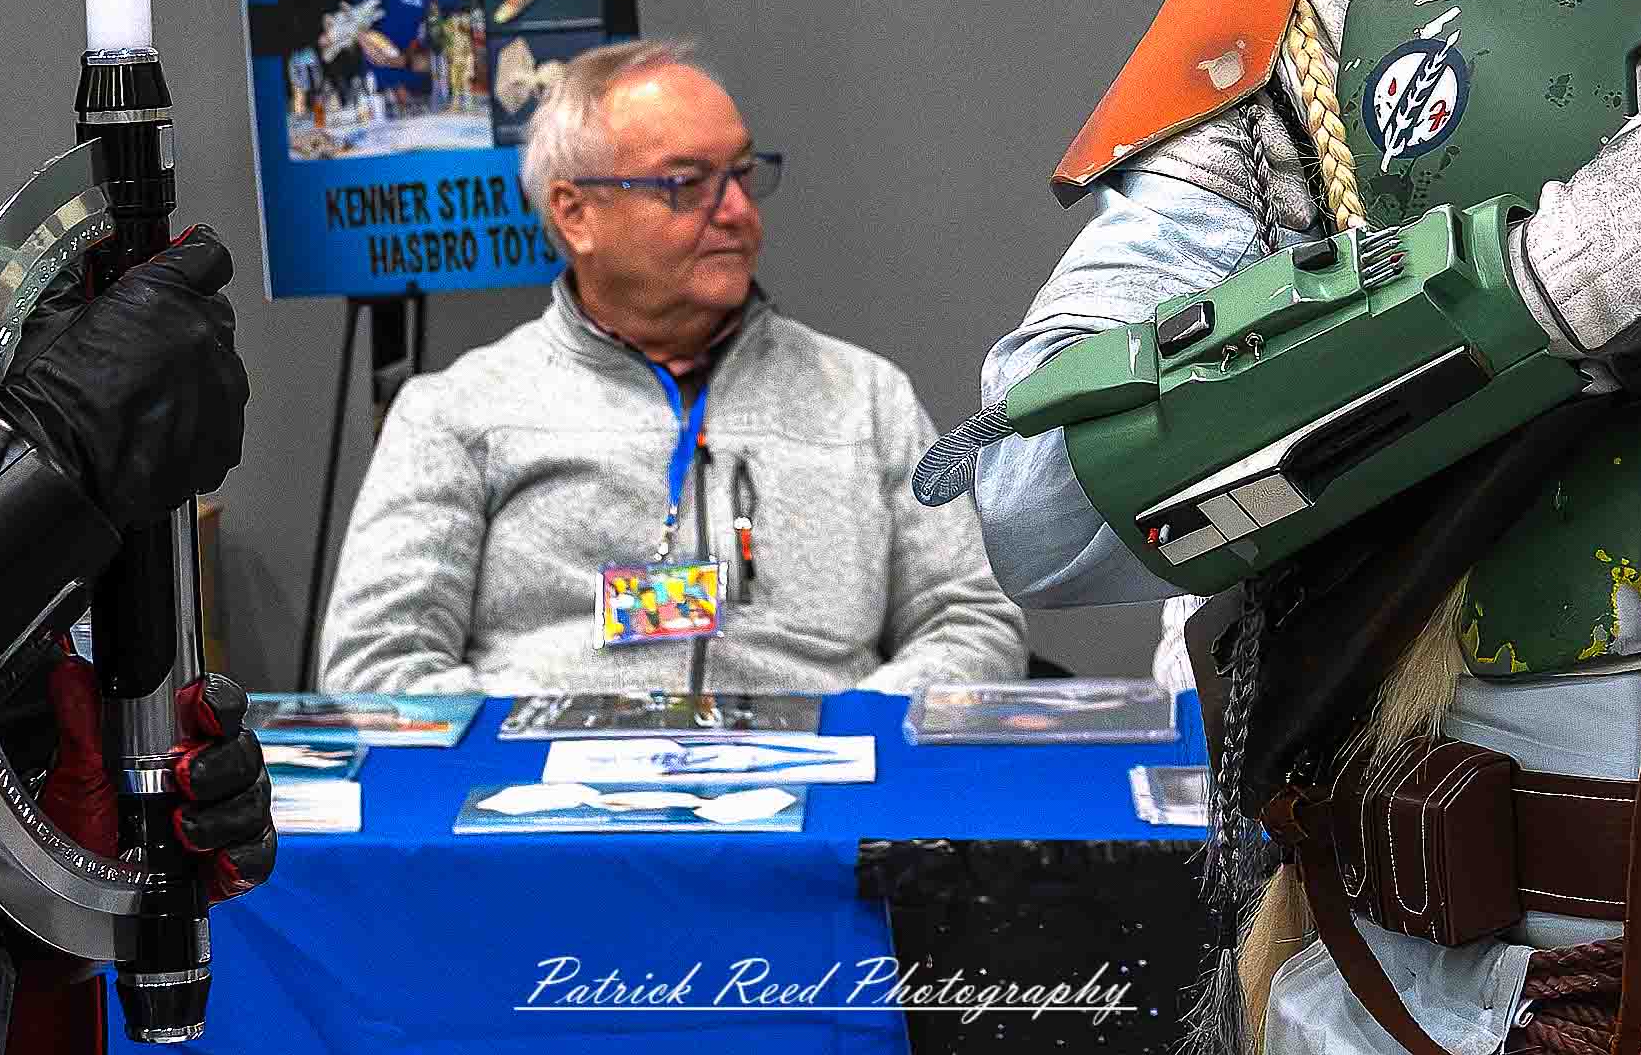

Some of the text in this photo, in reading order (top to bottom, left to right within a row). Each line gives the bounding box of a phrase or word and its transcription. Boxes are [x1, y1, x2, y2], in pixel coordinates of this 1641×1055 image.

[325, 184, 429, 228] KENNER
[438, 177, 509, 219] STAR
[369, 221, 558, 276] HASBRO TOYS
